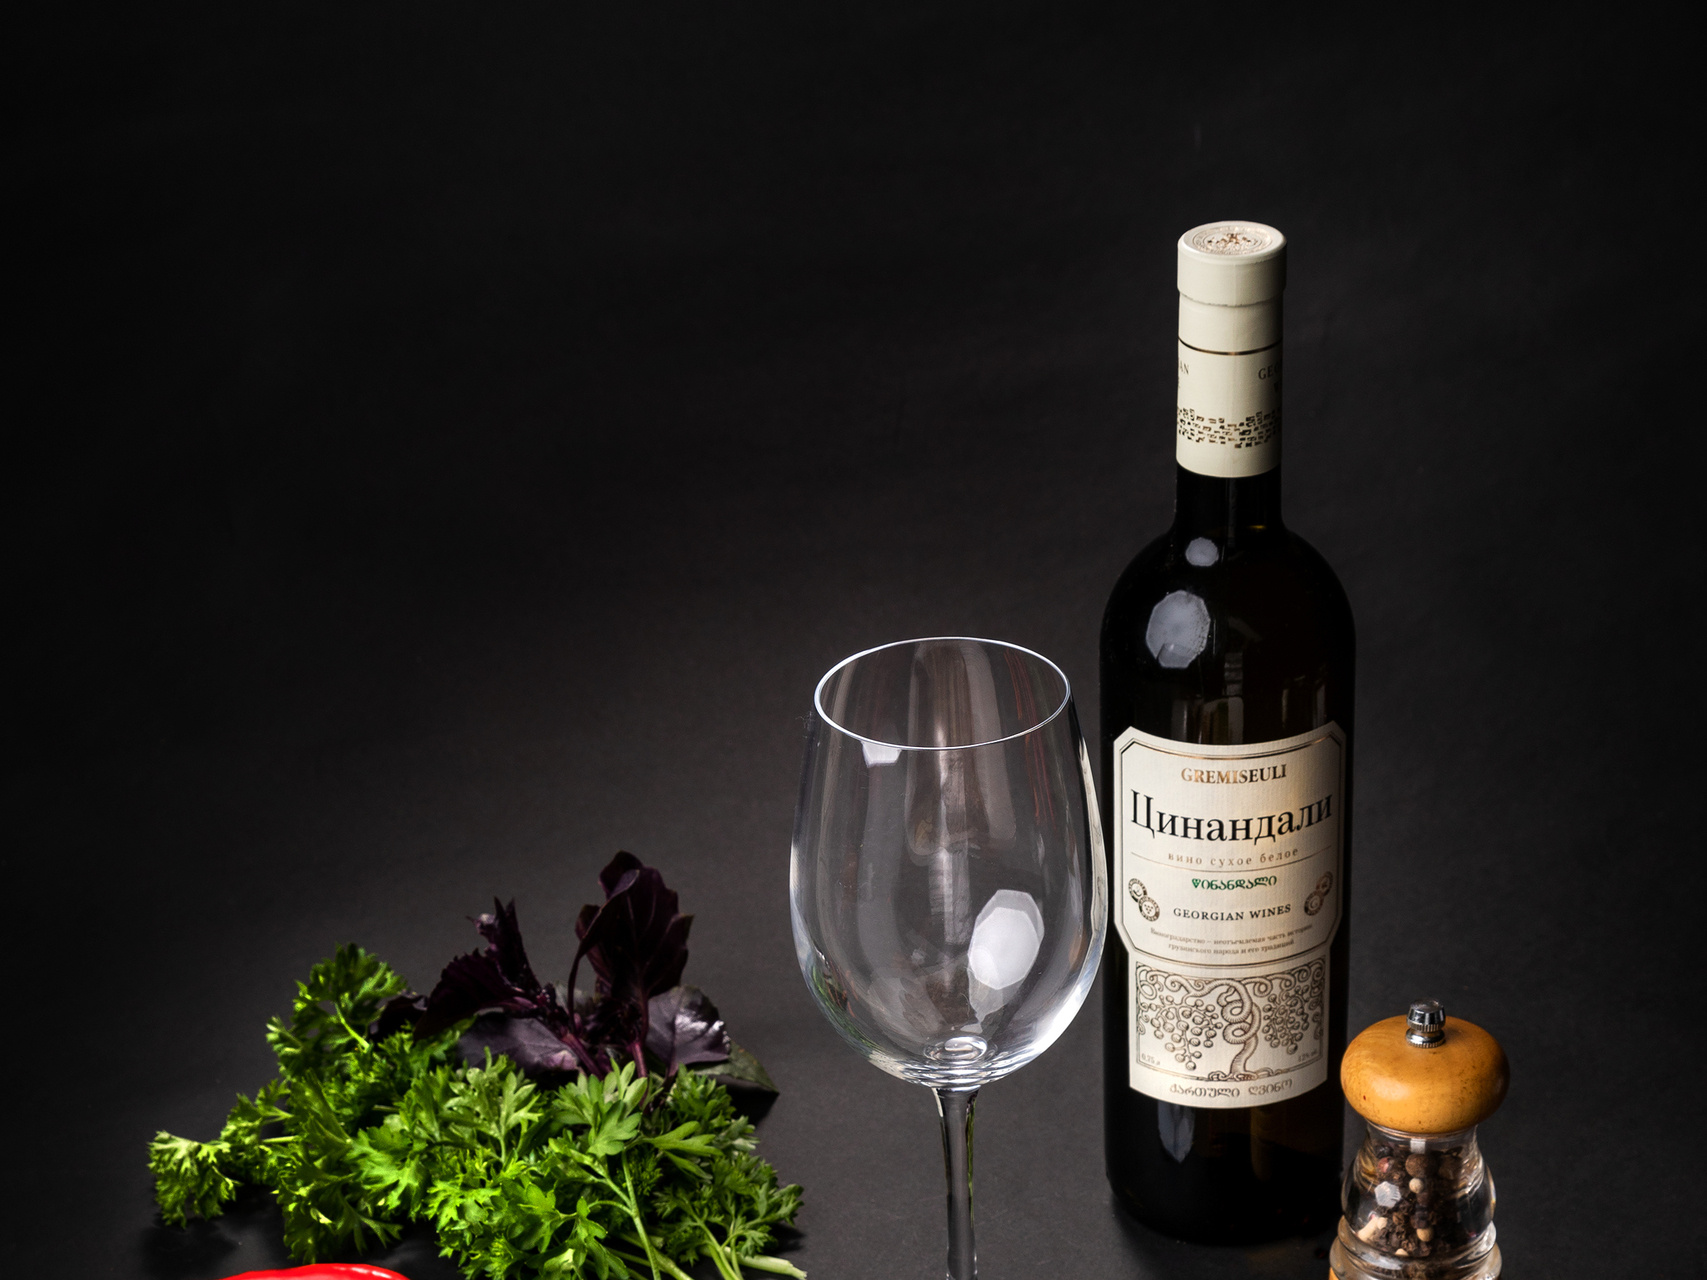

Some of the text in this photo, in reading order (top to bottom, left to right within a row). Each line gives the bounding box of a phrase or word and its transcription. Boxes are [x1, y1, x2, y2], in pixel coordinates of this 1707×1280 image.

[1181, 763, 1287, 785] GREMISEULI
[1130, 788, 1333, 846] Цинандали
[1168, 848, 1299, 869] вино сухое белое
[1173, 903, 1292, 921] GEORGIAN WINES
